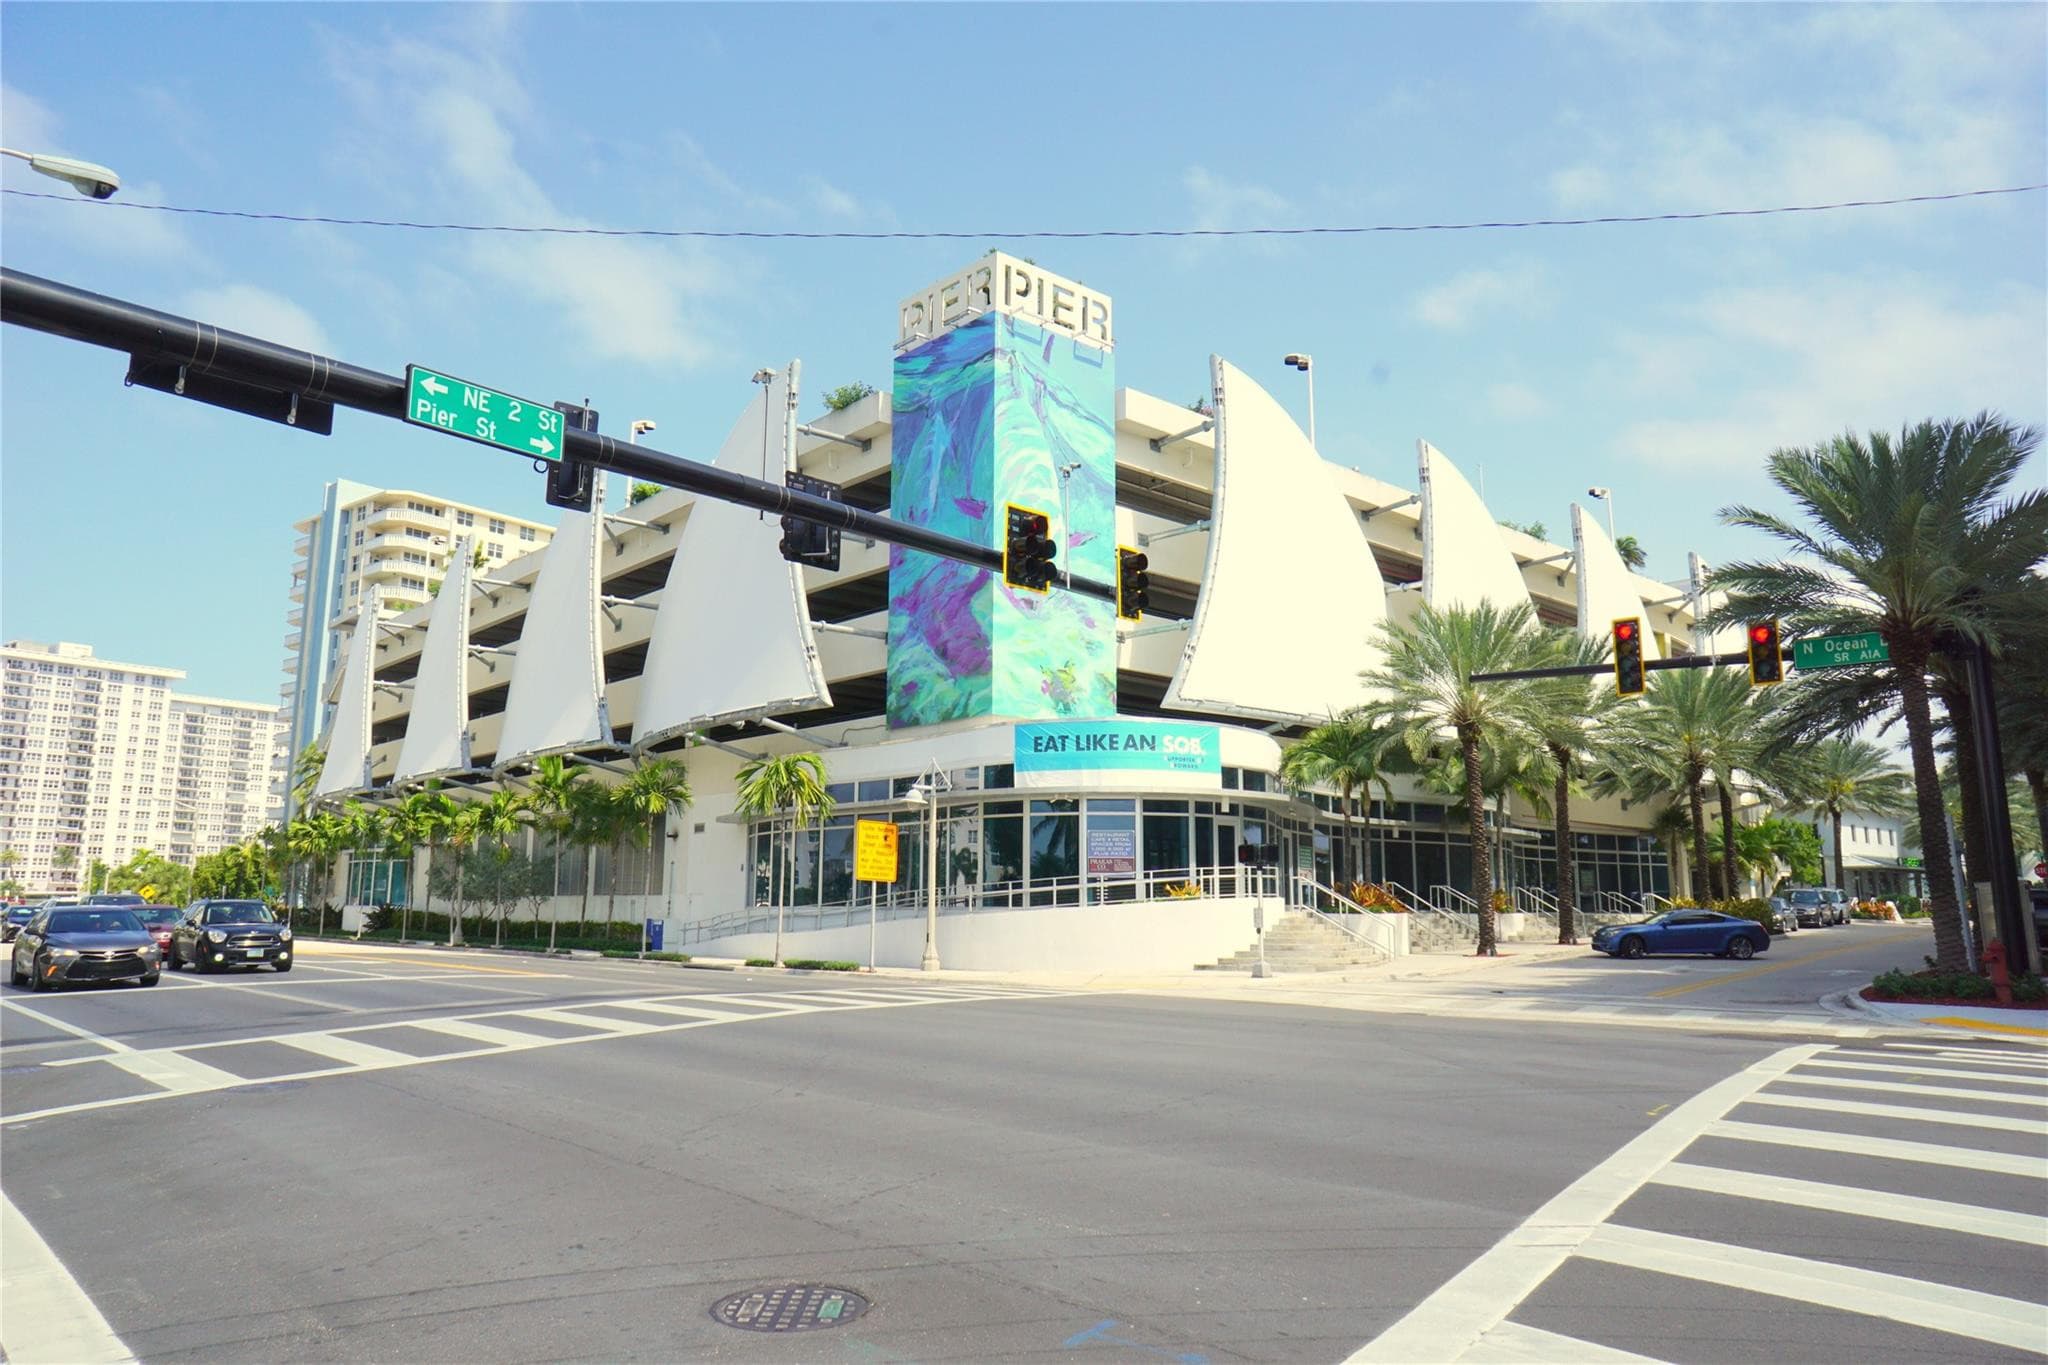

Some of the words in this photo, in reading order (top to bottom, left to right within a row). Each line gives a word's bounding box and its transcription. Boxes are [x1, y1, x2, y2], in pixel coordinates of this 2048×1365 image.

[903, 266, 992, 340] PIER
[1004, 264, 1109, 341] PIER
[416, 398, 458, 428] Pier
[476, 417, 497, 441] St
[463, 386, 491, 413] NE
[508, 401, 522, 423] 2
[538, 411, 558, 433] St
[1803, 642, 1813, 655] N
[1824, 638, 1868, 652] Ocean
[1834, 652, 1850, 662] SR
[1033, 735, 1069, 753] EAT
[1075, 734, 1119, 752] LIKE
[1124, 734, 1156, 752] AN
